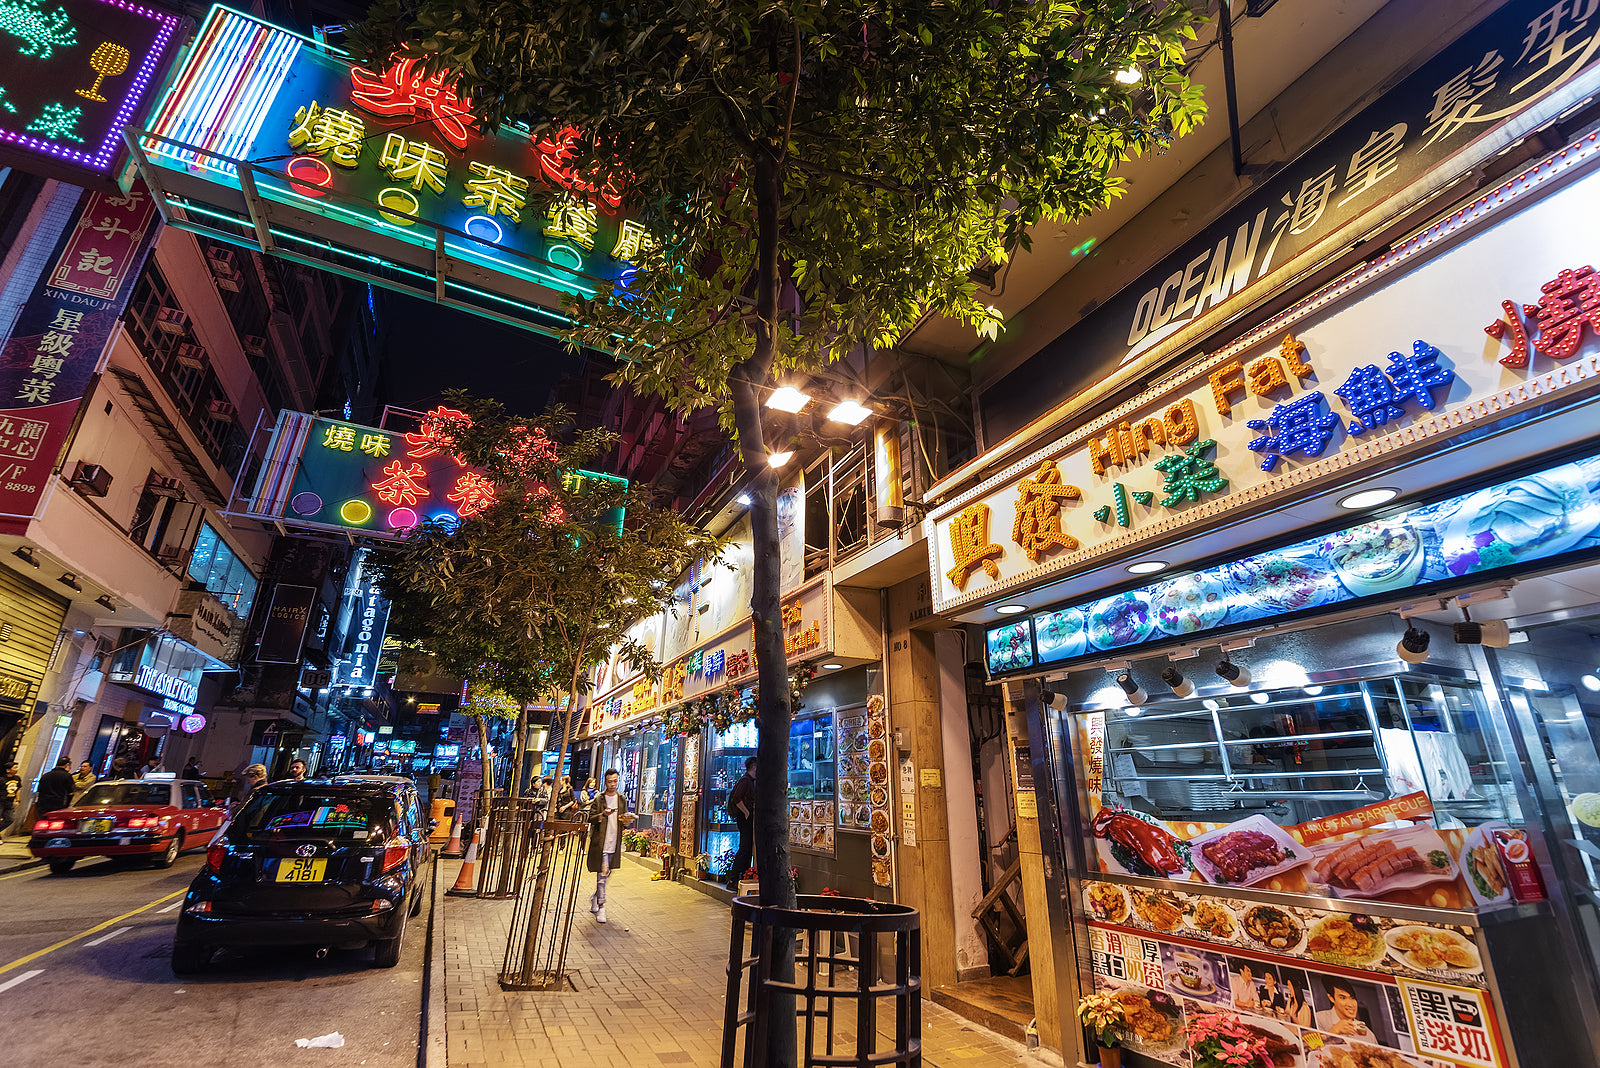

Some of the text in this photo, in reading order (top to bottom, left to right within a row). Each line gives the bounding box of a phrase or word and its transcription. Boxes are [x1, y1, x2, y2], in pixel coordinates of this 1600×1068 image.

[1127, 206, 1269, 347] OCEAN
[43, 288, 112, 312] XIN DAU JI
[1087, 332, 1314, 476] Hing Fat
[322, 423, 393, 459] 燒味
[1092, 437, 1230, 528] 小菜
[1246, 339, 1456, 473] 海鮮
[4, 482, 36, 494] 8898
[138, 664, 198, 706] THE ASHLEY ROAD
[1088, 716, 1104, 795] 興發燒味
[1334, 814, 1354, 830] FAT
[1356, 795, 1429, 824] BARBECUE
[284, 869, 318, 881] 4181
[293, 859, 315, 870] SM
[1092, 951, 1165, 991] 黑白奶茶
[1424, 1018, 1492, 1062] 淡奶
